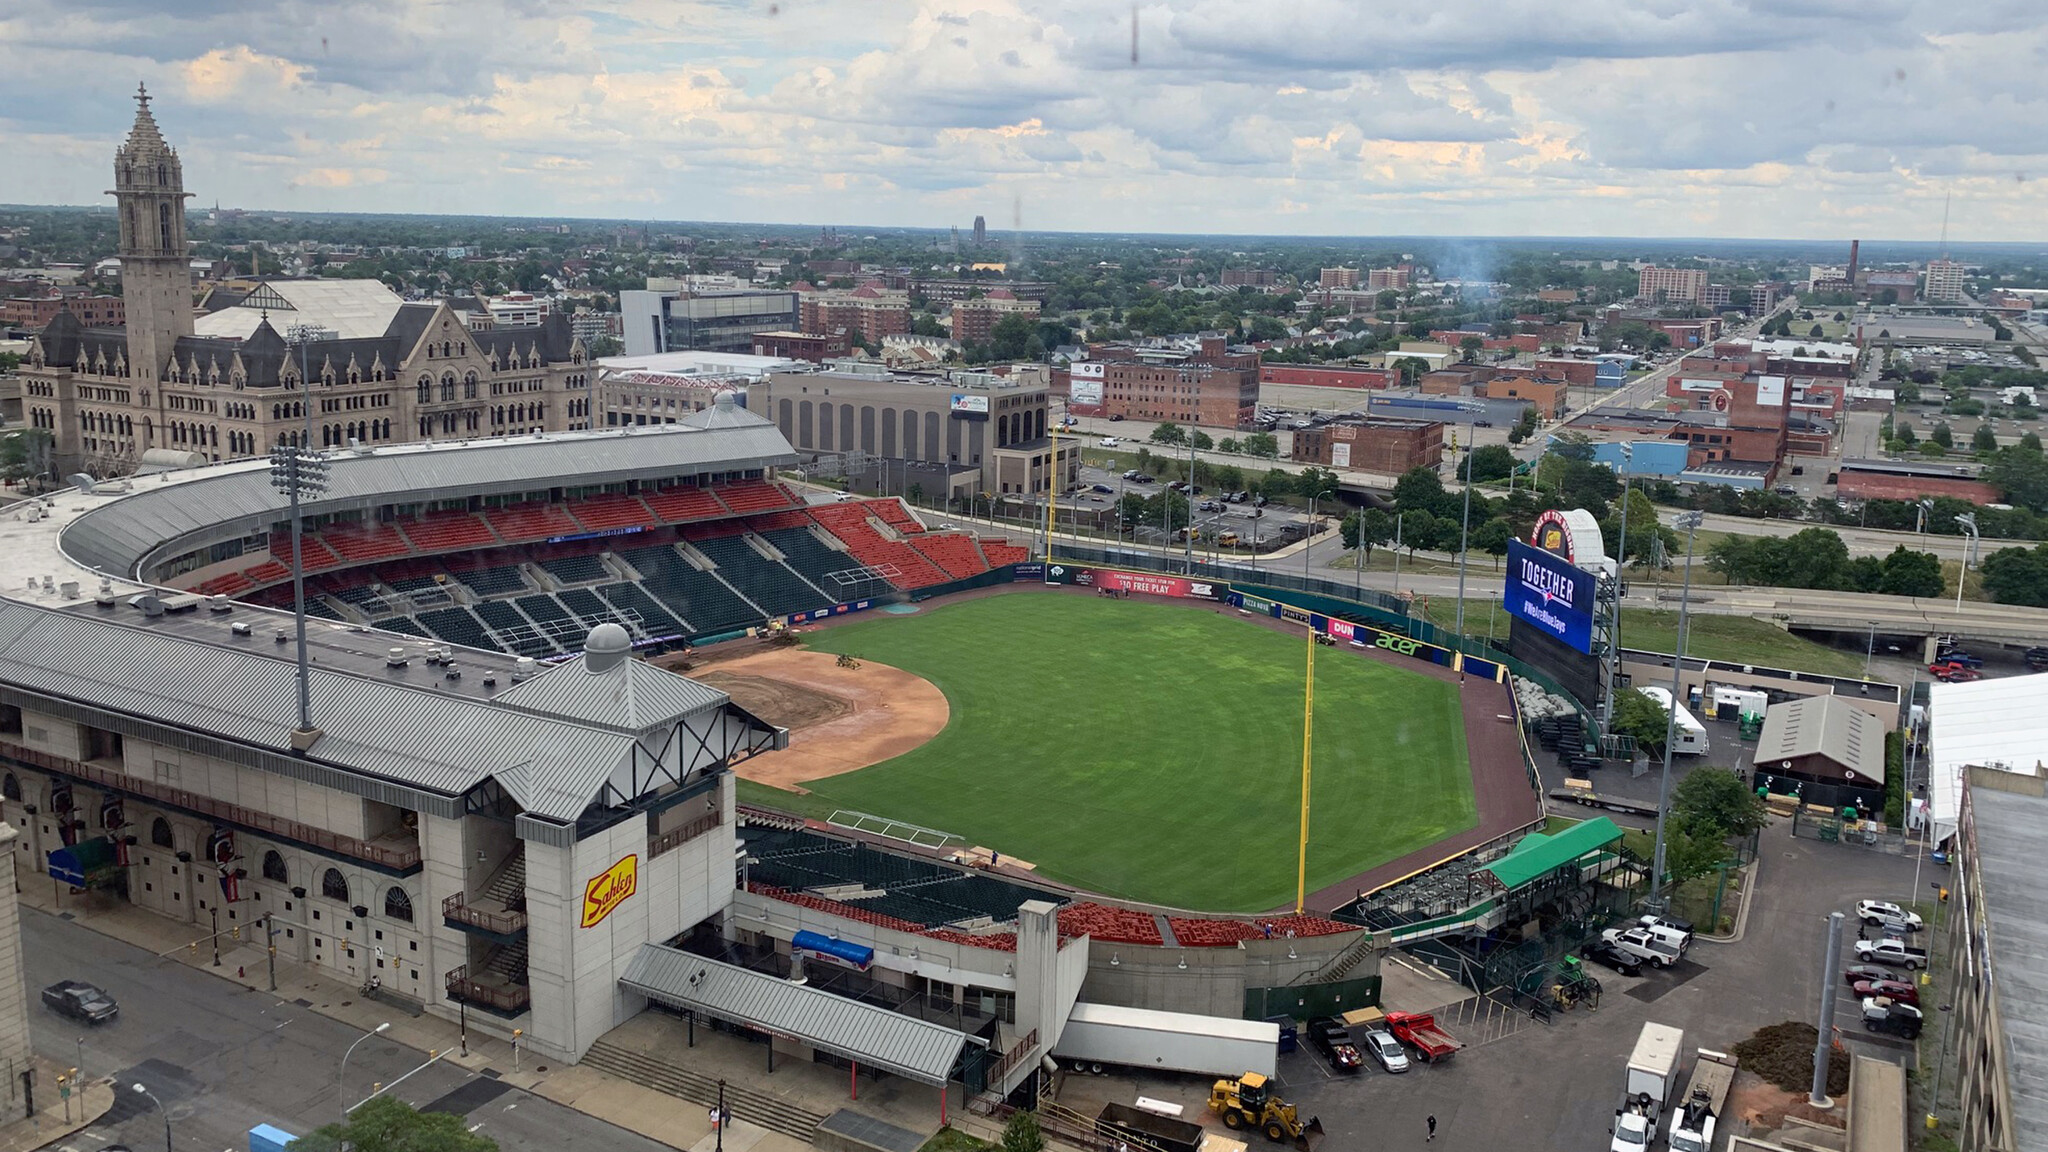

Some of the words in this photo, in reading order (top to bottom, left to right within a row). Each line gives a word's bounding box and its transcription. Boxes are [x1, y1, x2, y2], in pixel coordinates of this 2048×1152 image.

[1133, 582, 1149, 592] FREE
[1151, 584, 1169, 594] PLAY
[1521, 558, 1574, 603] TOGETHER
[1243, 598, 1256, 608] PIZZA
[1256, 602, 1269, 612] NOVA
[1283, 609, 1309, 622] PINTY'S
[1523, 600, 1566, 635] #WeAreBlueJays
[1333, 622, 1354, 637] DUN
[1375, 633, 1422, 656] acer
[588, 872, 632, 921] Sahlen
